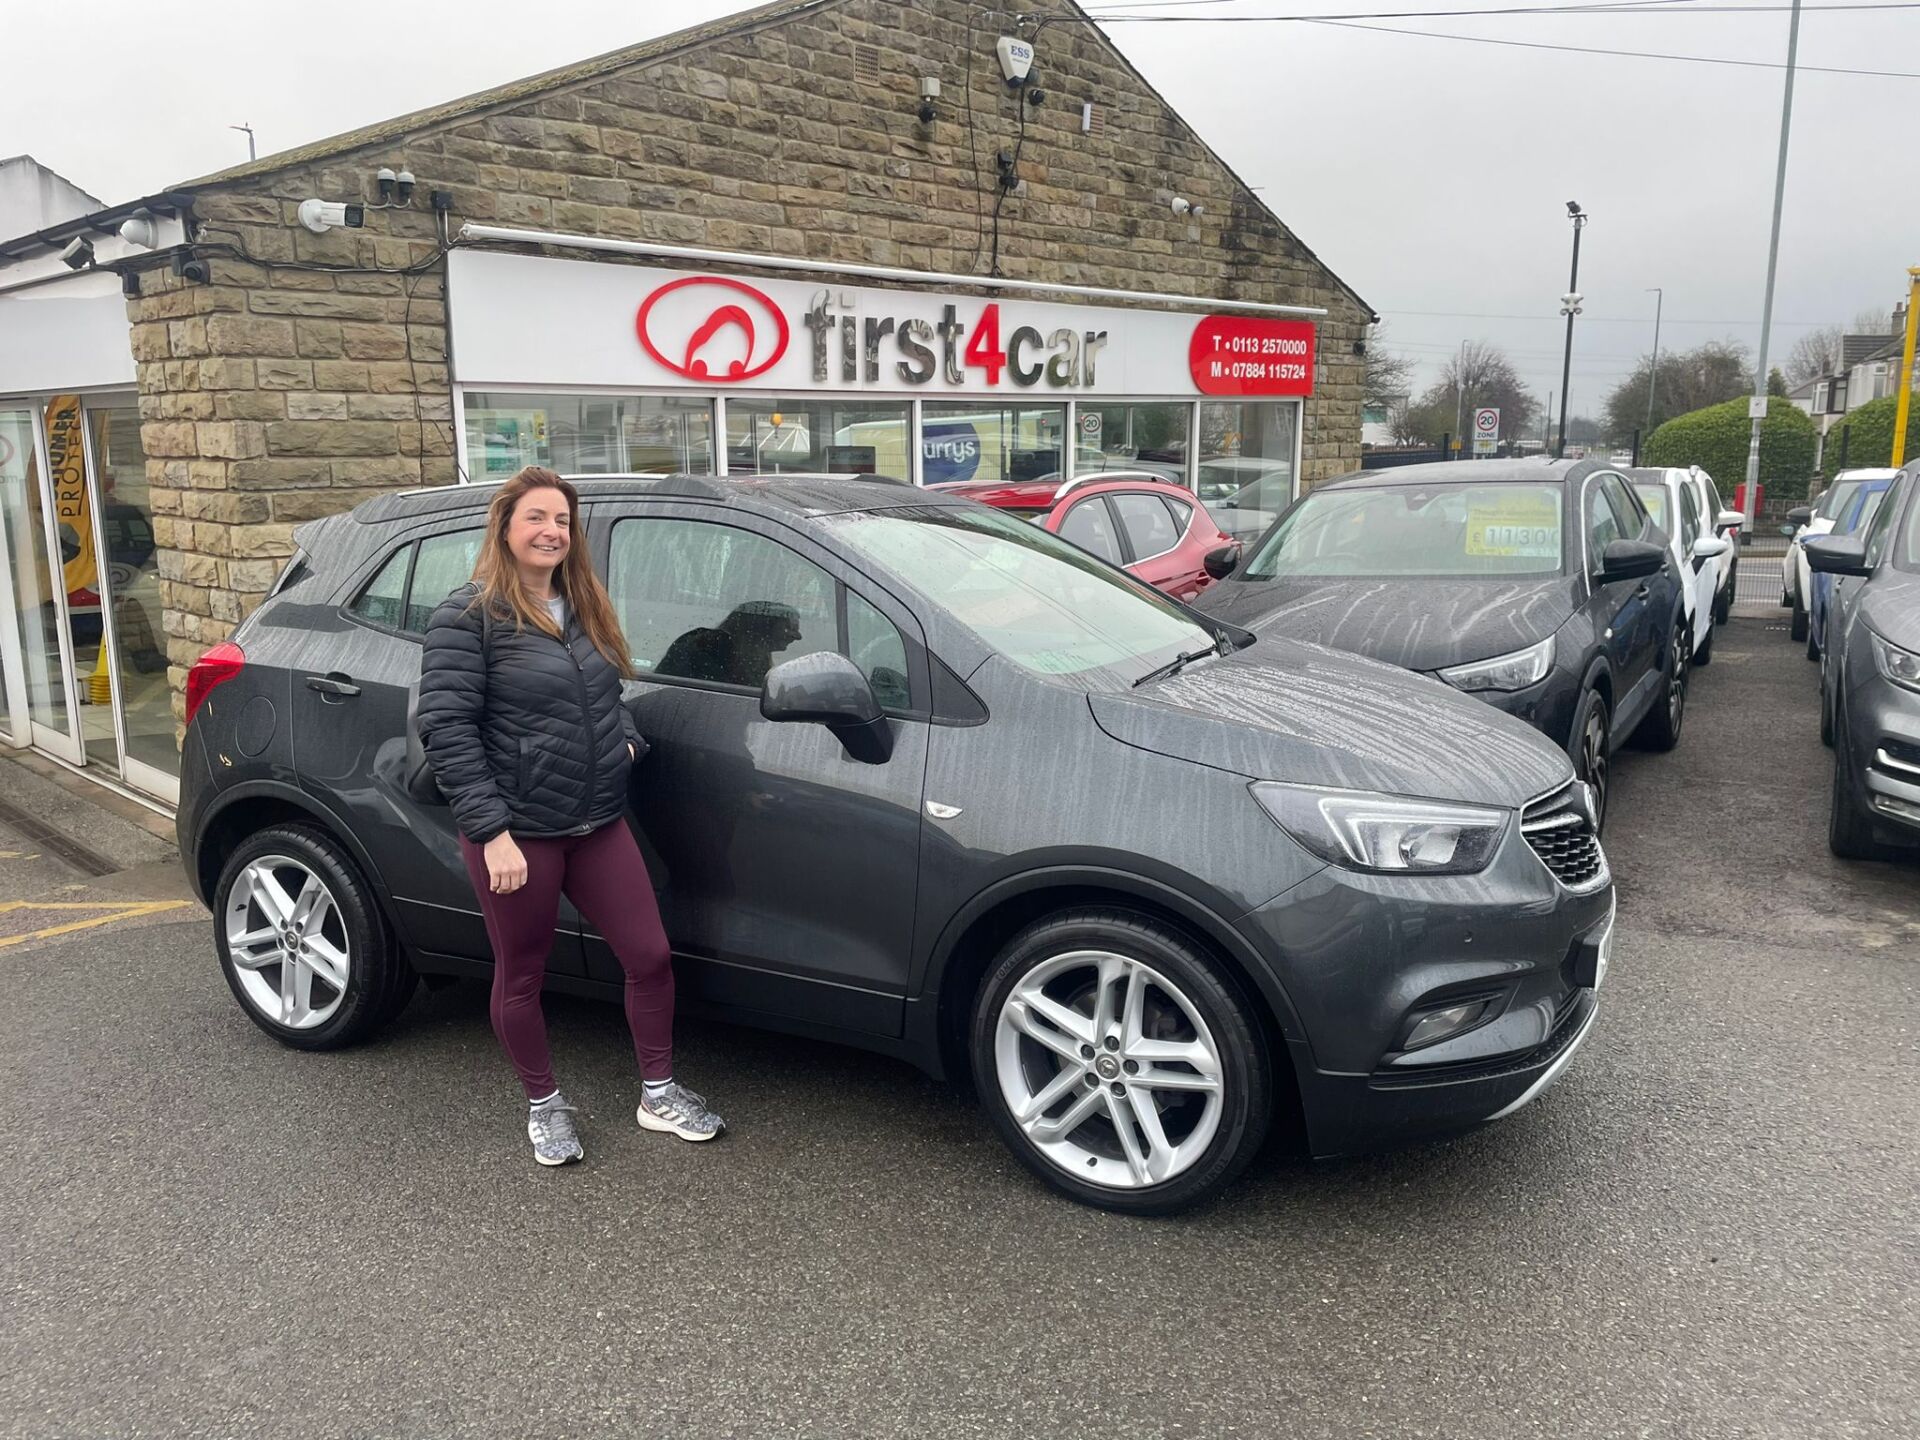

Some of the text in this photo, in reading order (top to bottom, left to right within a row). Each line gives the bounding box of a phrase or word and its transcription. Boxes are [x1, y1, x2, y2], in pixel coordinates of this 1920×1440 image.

[1010, 45, 1030, 59] ESS
[804, 288, 1108, 387] first4car
[1261, 338, 1307, 355] 2570000
[1268, 364, 1306, 379] 115724
[1085, 419, 1098, 428] 20
[1480, 416, 1494, 425] 20
[923, 440, 976, 463] urrys
